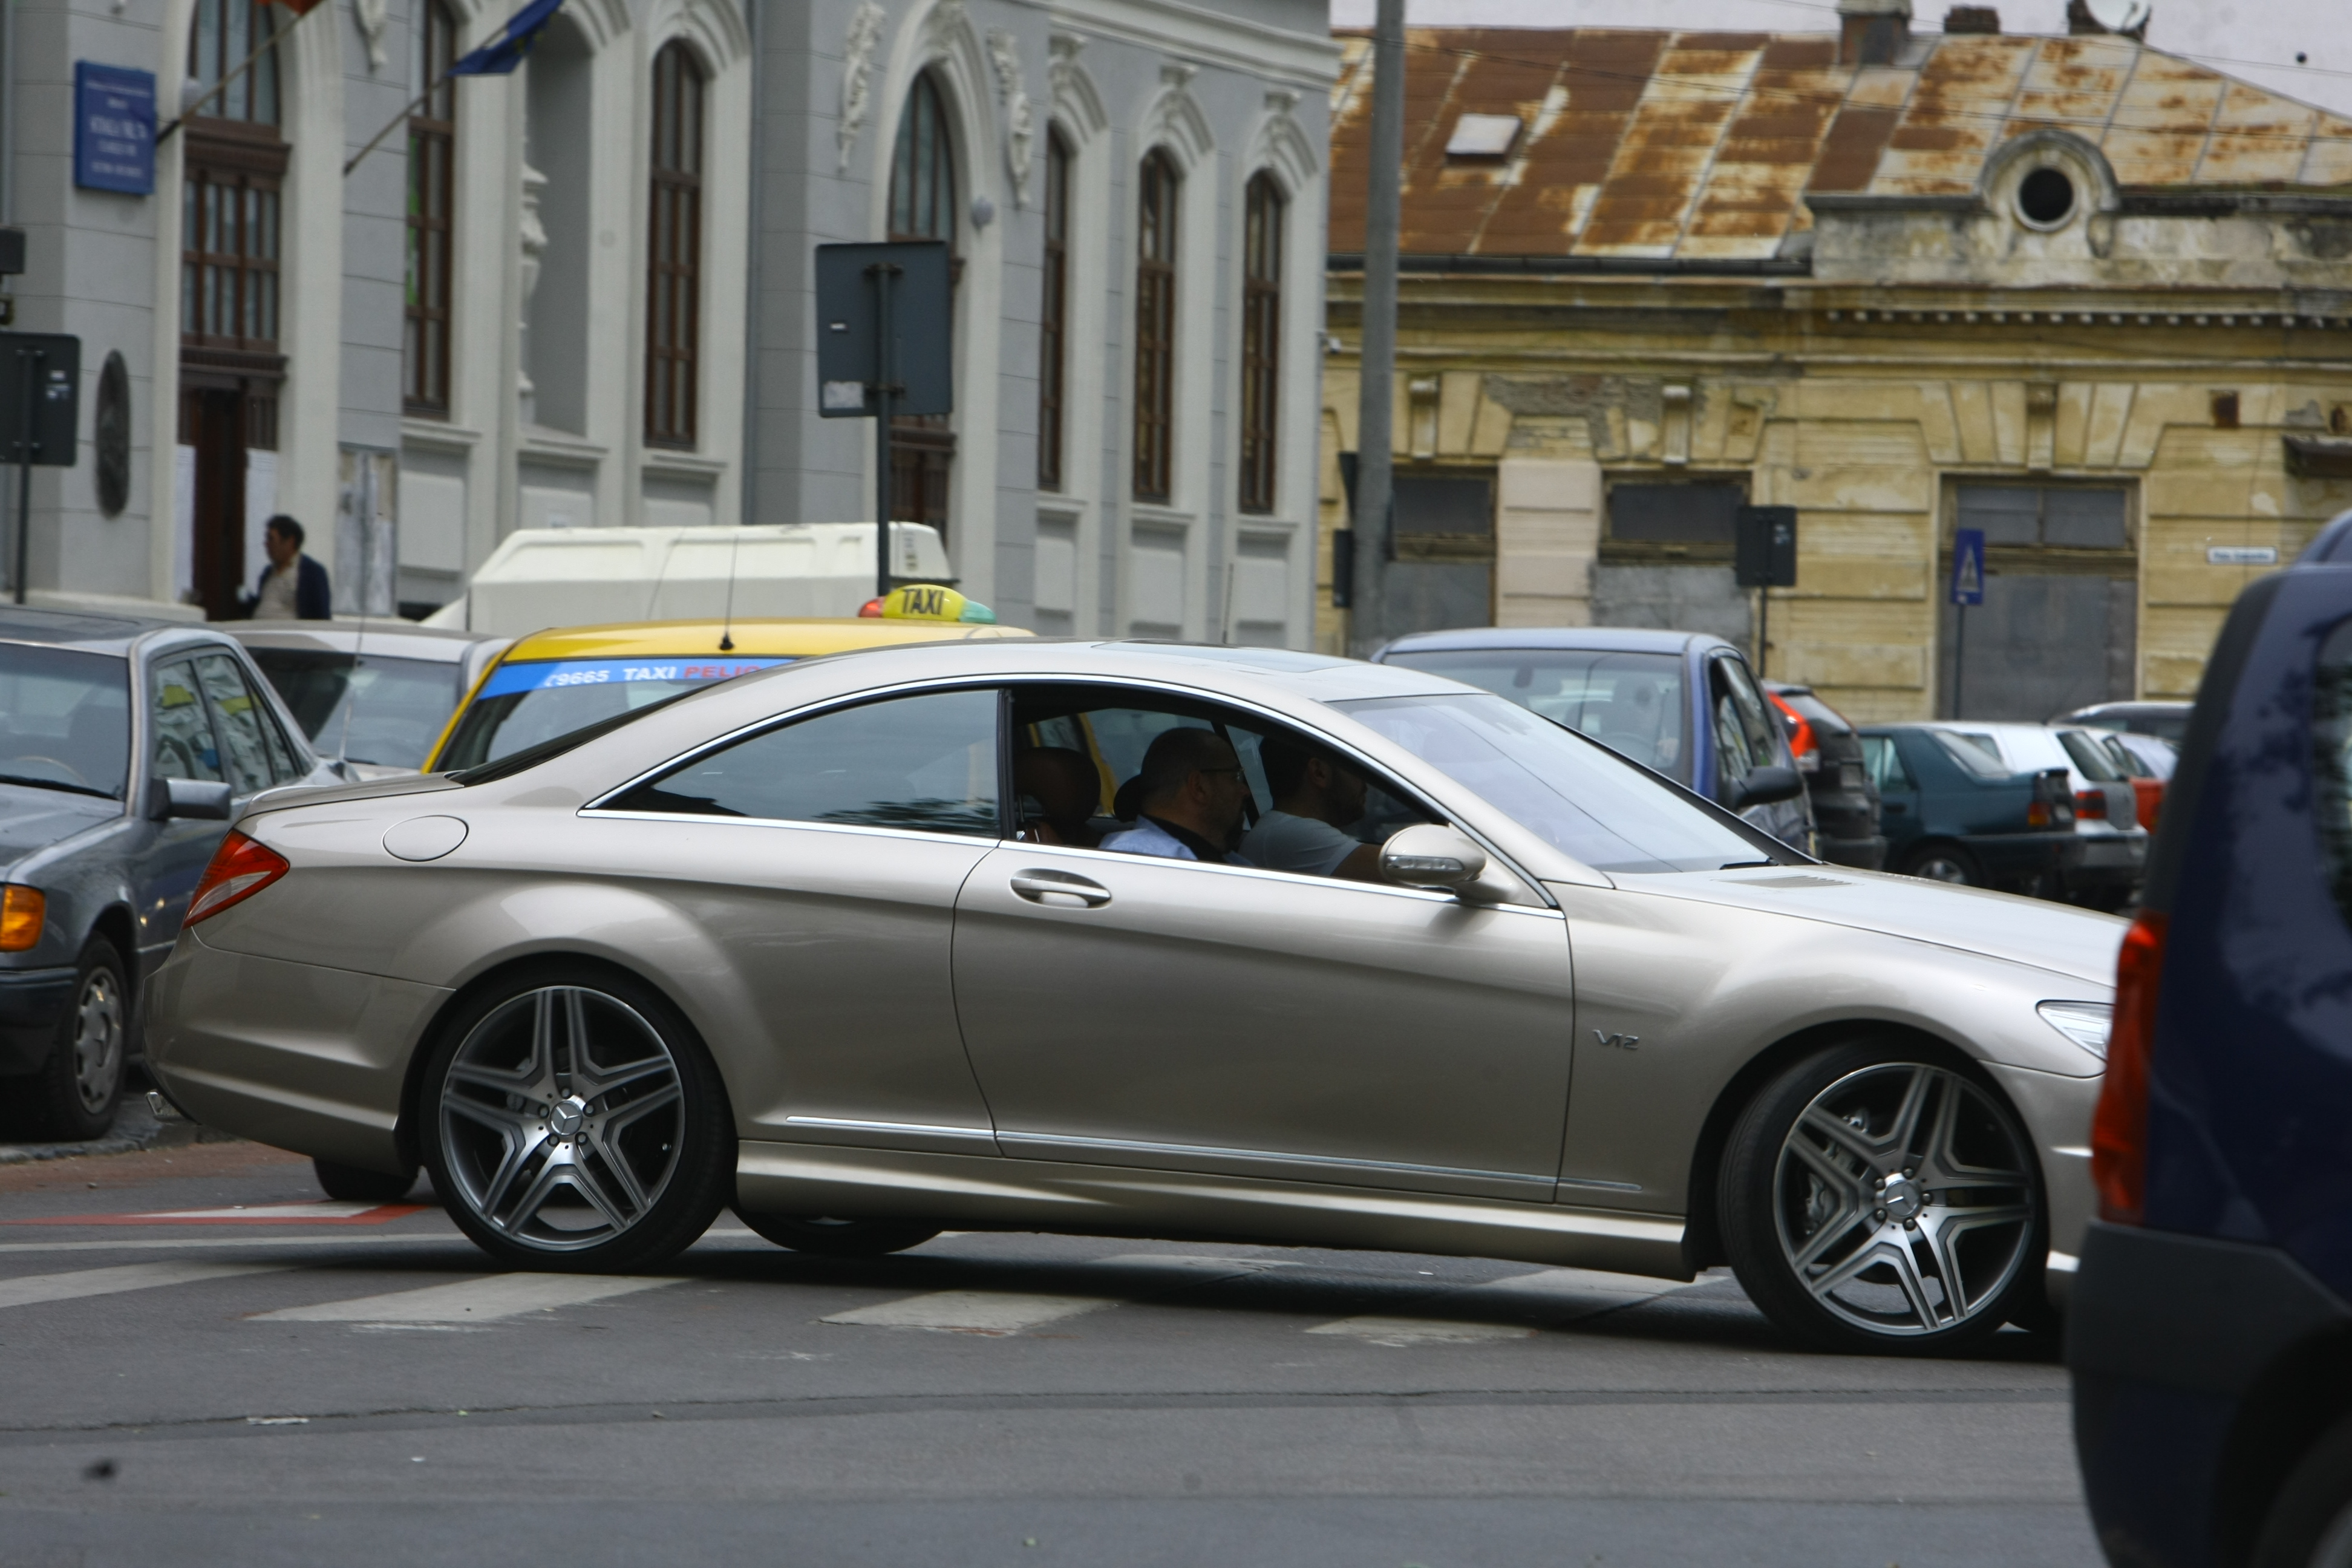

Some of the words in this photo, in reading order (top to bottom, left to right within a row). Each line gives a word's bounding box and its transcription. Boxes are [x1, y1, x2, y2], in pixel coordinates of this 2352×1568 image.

[902, 588, 944, 615] TAXI
[623, 666, 677, 681] TAXI
[1592, 1028, 1639, 1050] V12
